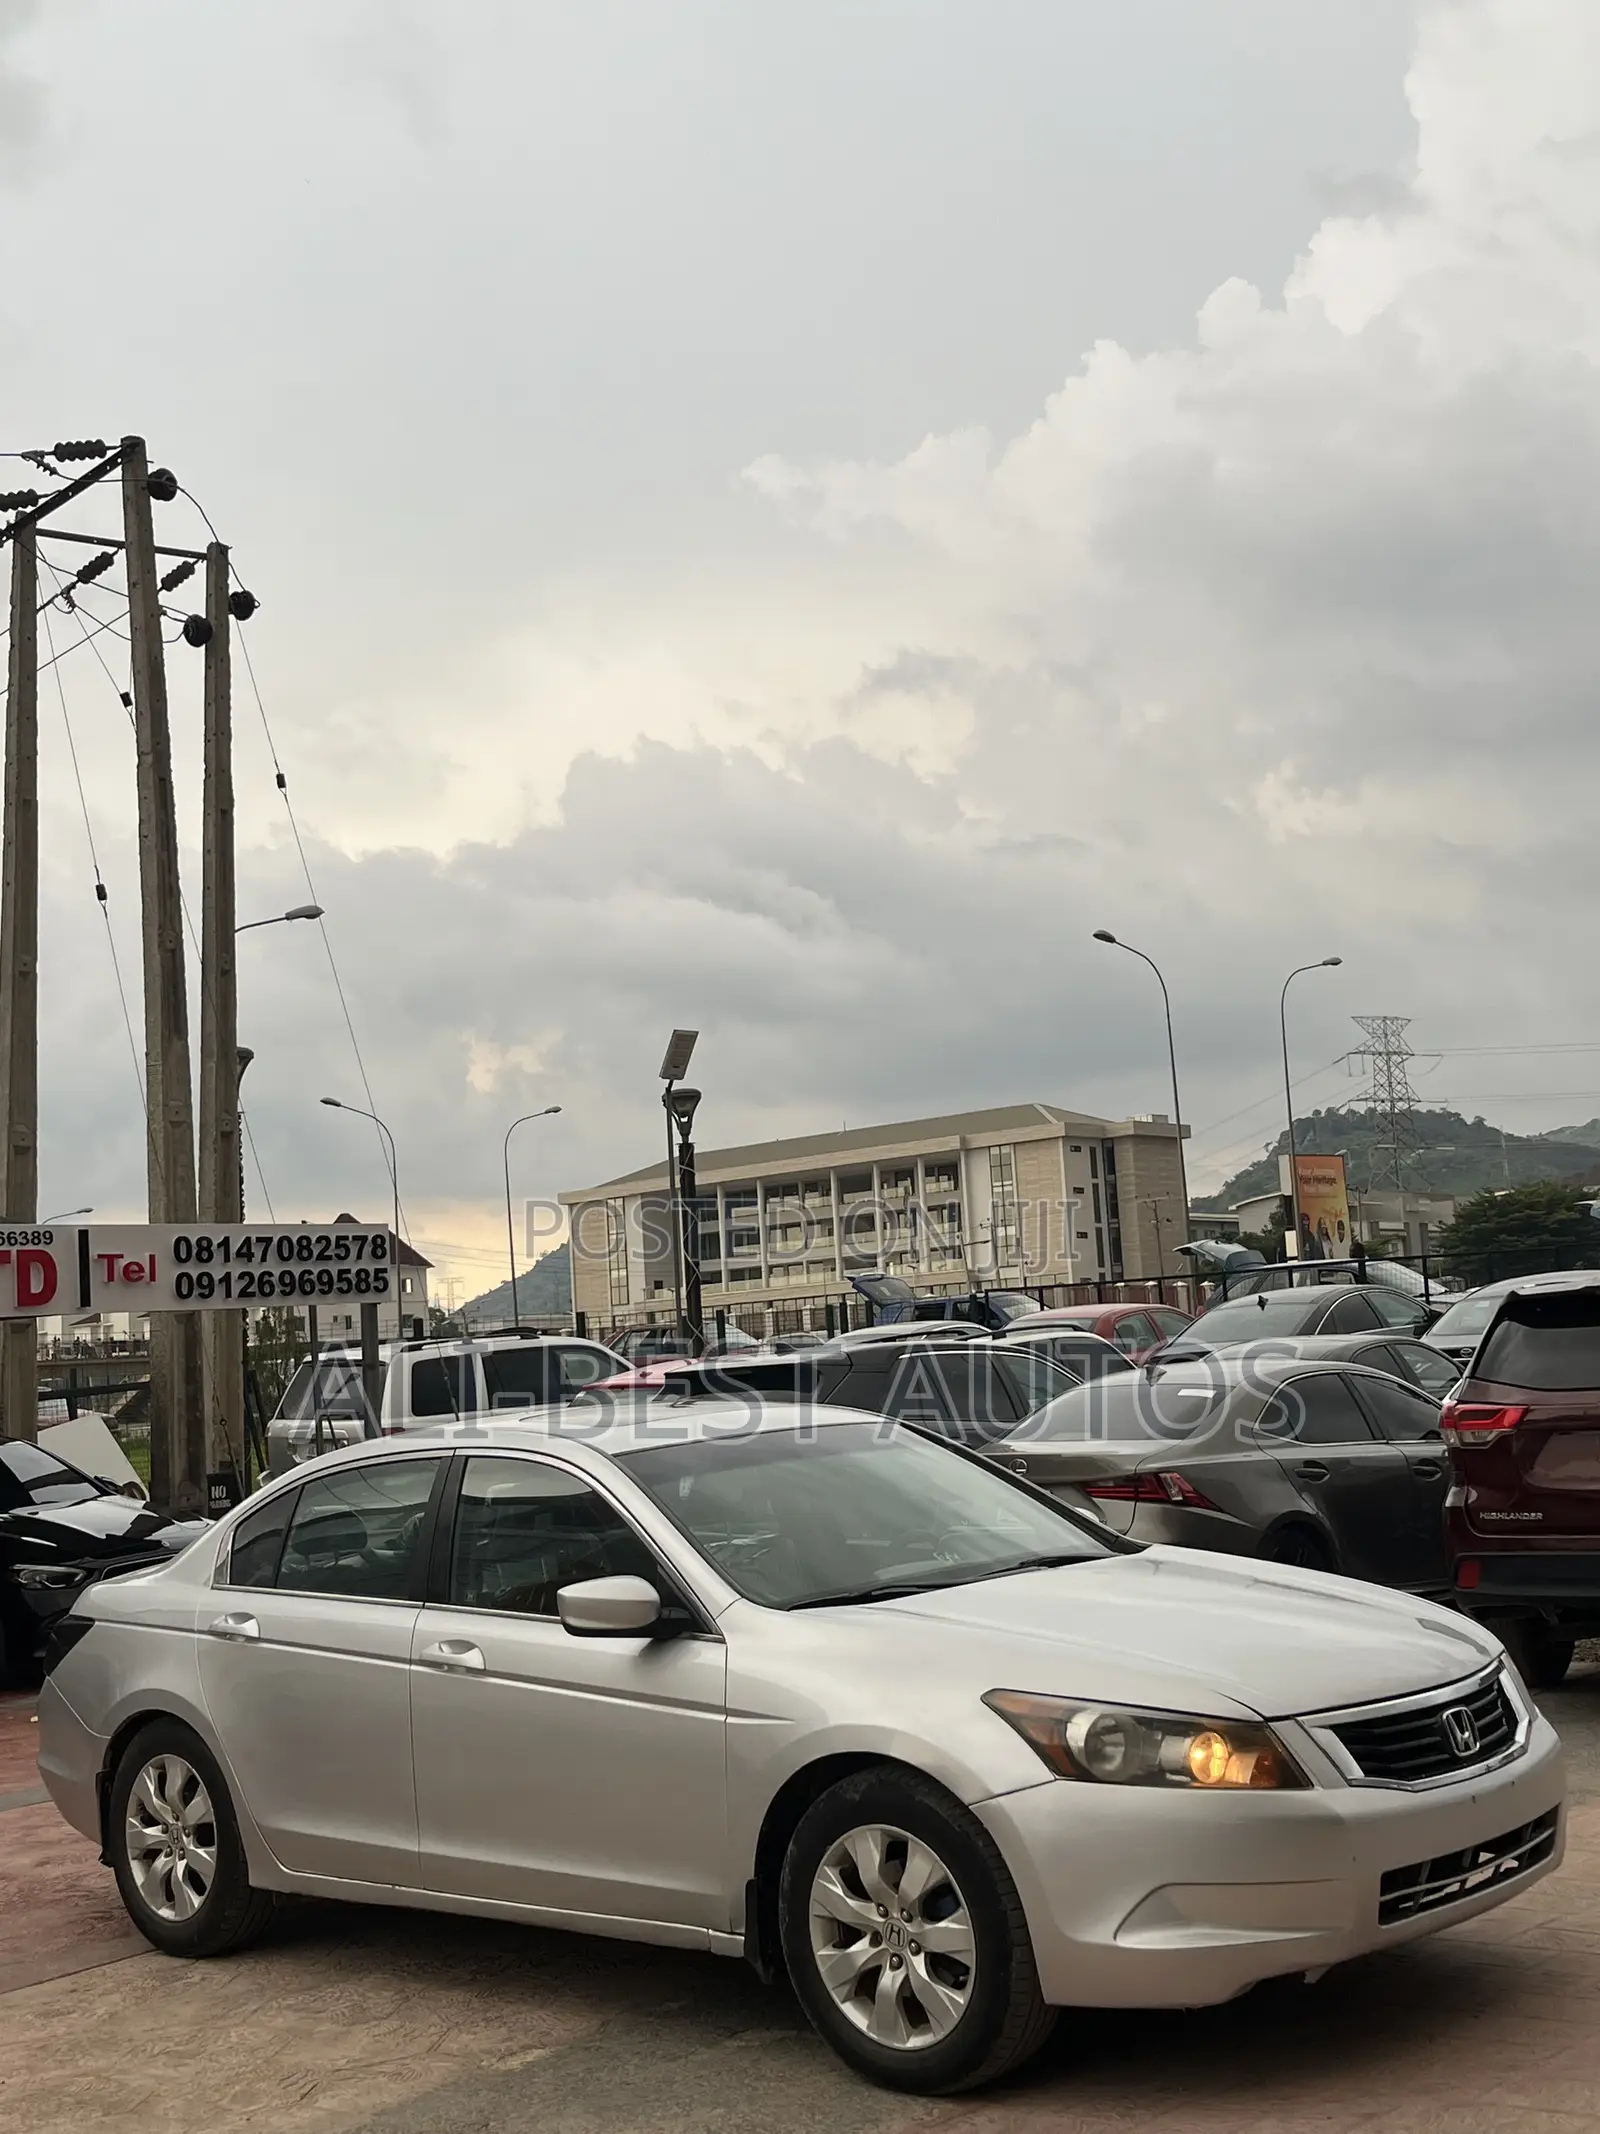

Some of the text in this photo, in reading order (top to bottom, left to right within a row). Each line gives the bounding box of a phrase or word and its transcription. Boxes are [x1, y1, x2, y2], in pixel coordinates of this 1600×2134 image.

[173, 1234, 387, 1263] 08147082578
[97, 1253, 156, 1282] Tel
[175, 1268, 389, 1299] 09126969585
[211, 1485, 226, 1499] NO
